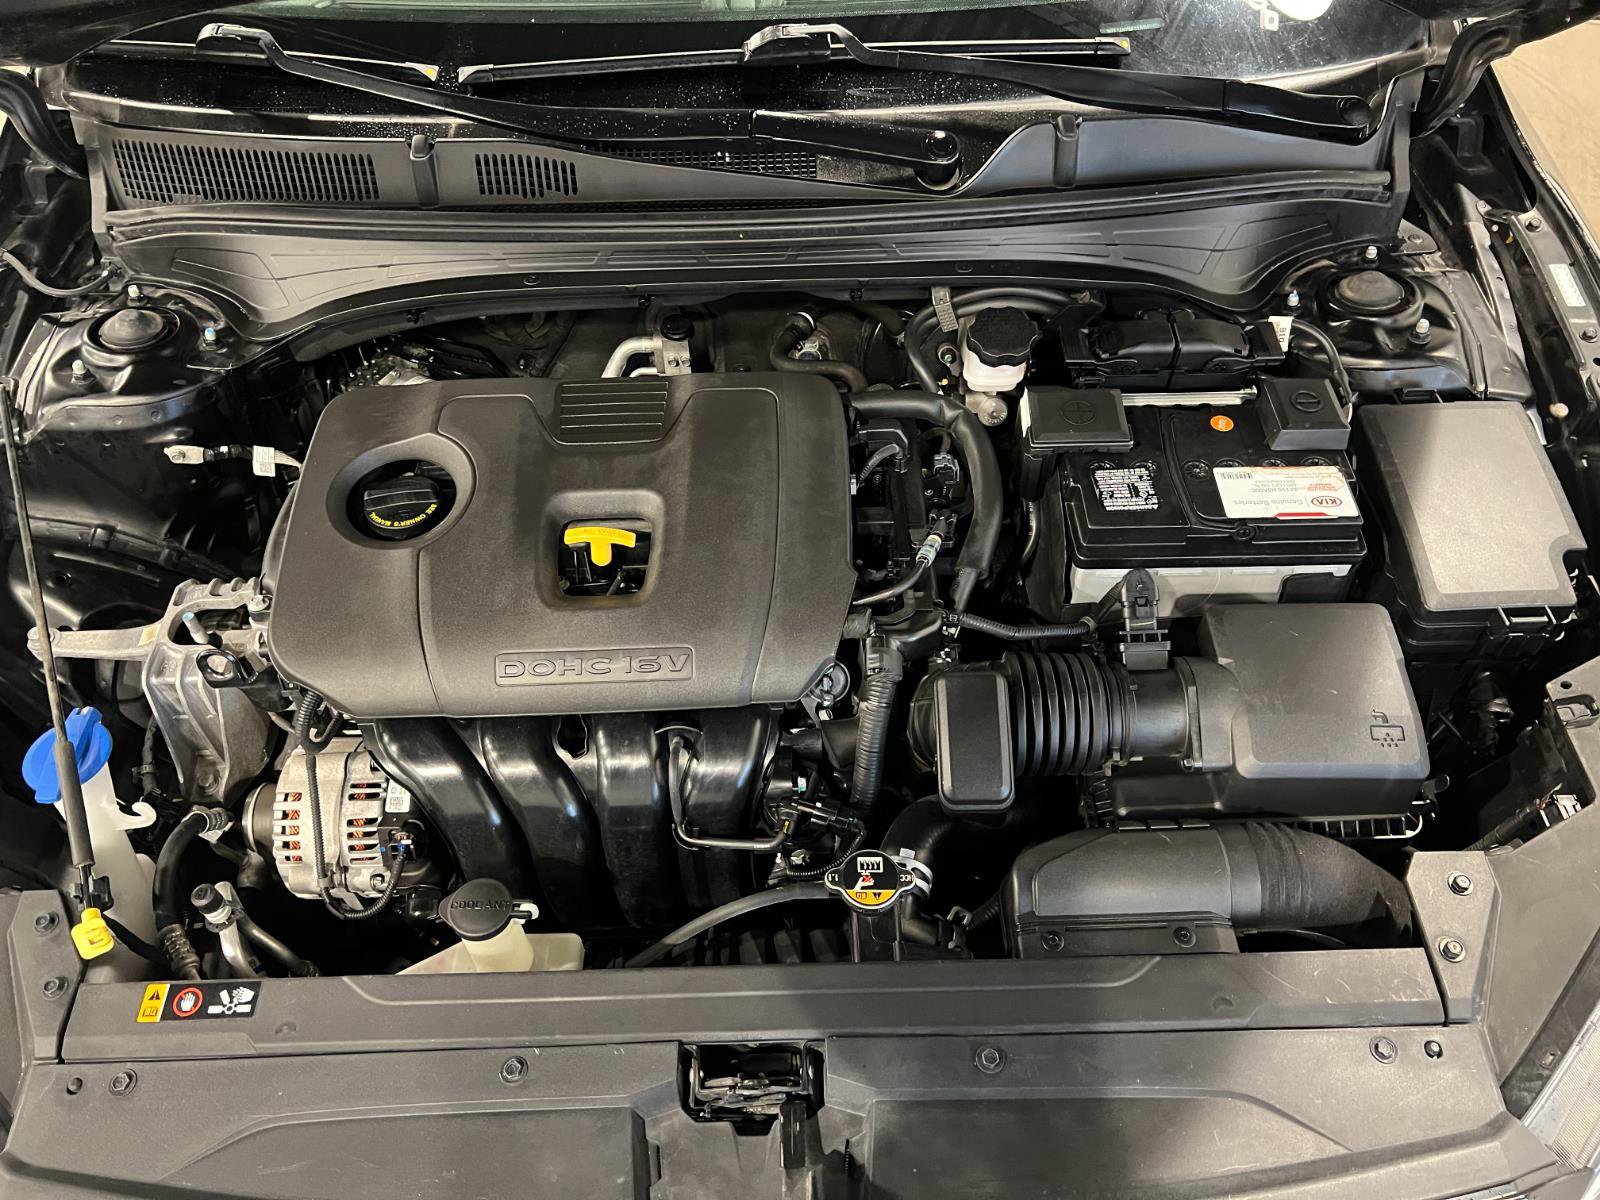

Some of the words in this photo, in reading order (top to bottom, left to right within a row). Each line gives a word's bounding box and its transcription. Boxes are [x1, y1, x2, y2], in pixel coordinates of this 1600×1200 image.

[1315, 497, 1338, 507] KIA
[499, 657, 612, 679] DOHC
[624, 653, 690, 674] 16V
[450, 899, 511, 910] COOLANT
